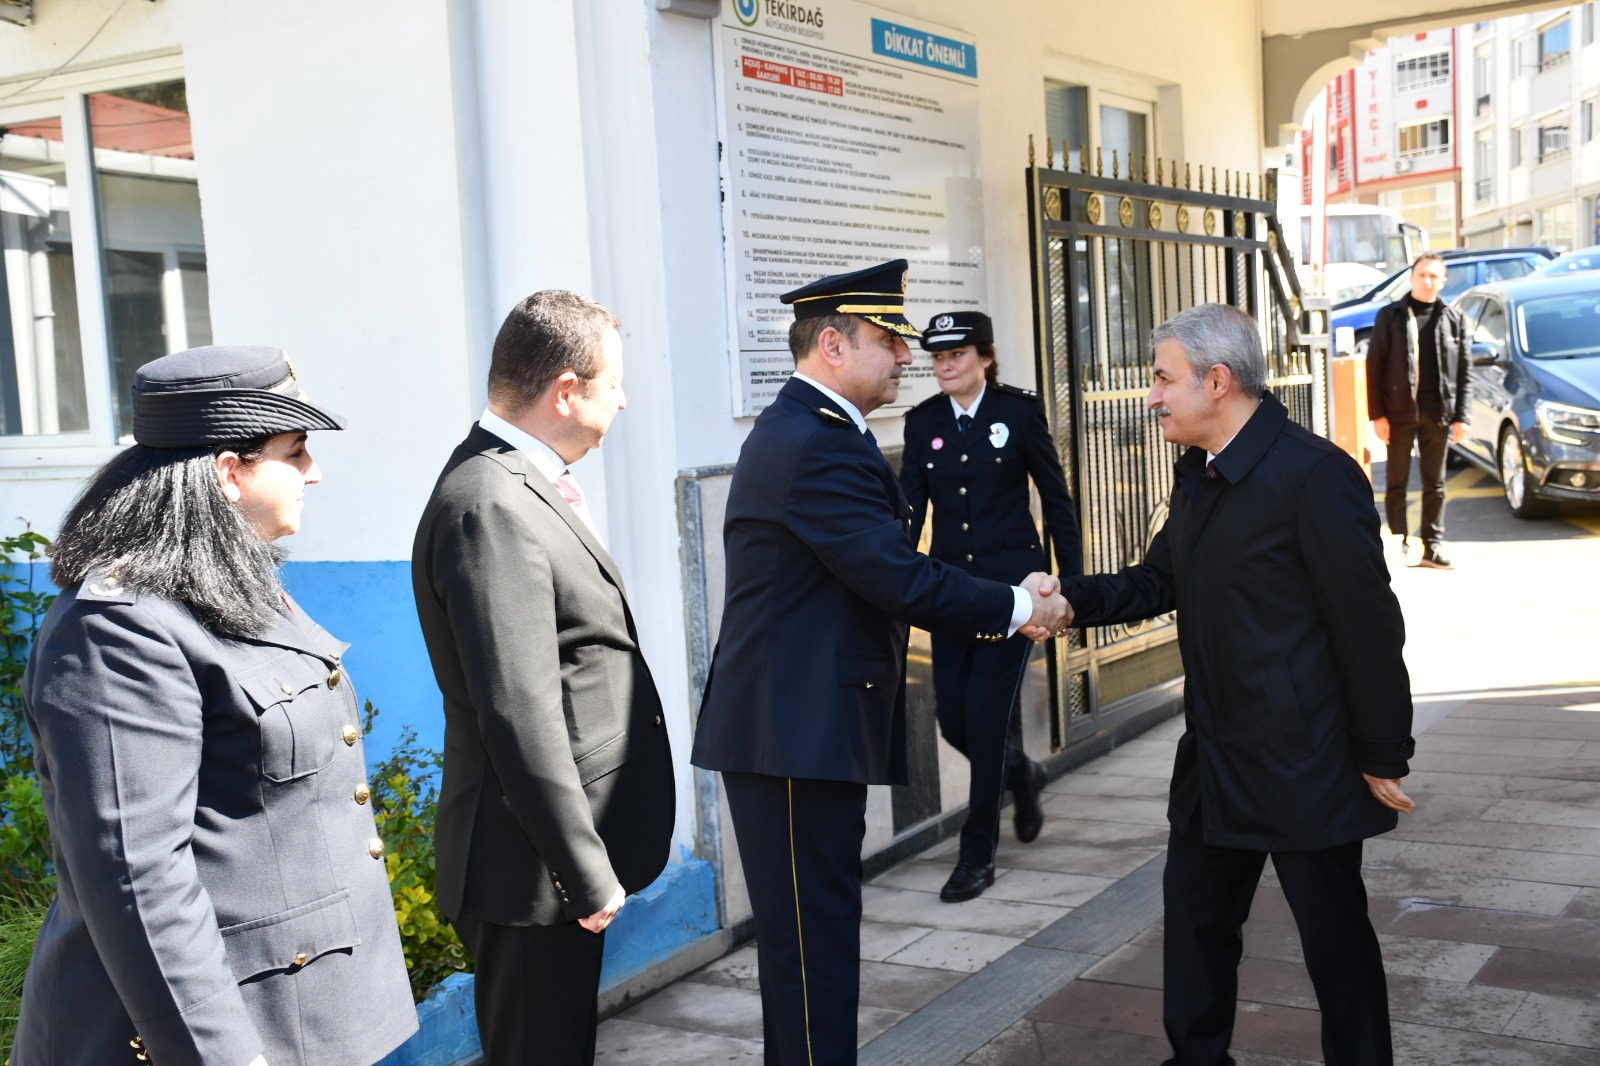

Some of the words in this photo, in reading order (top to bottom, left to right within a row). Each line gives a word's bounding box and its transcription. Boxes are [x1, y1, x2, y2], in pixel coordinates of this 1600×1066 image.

[765, 0, 823, 27] TEKİRDAĞ
[766, 18, 796, 33] BÜYÜKŞEHİR
[798, 27, 824, 40] BELEDİYESİ
[884, 26, 923, 59] DİKKAT
[926, 36, 965, 69] ÖNEMLİ
